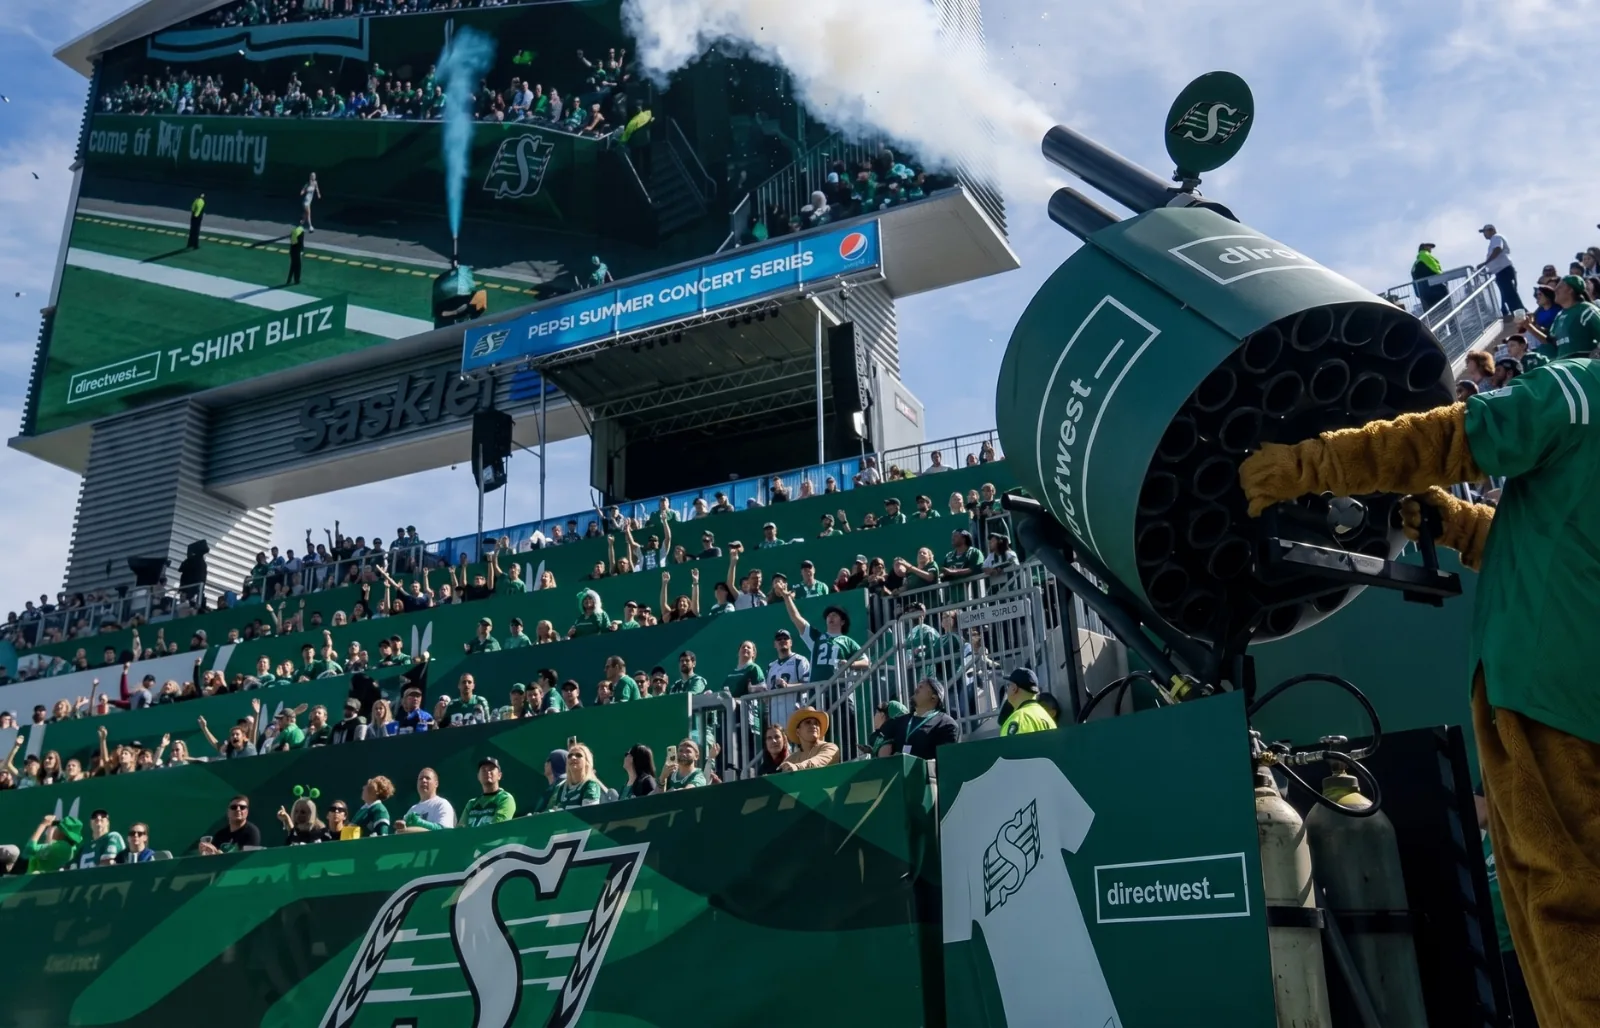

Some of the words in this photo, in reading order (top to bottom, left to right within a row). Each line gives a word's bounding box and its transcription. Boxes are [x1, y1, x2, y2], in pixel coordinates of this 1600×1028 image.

[189, 123, 268, 175] Country
[527, 316, 575, 340] PEPSI
[579, 293, 654, 326] SUMMER
[658, 267, 746, 303] CONCERT
[750, 250, 814, 280] SERIES
[167, 326, 260, 372] T-SHIRT
[265, 305, 334, 346] BLITZ
